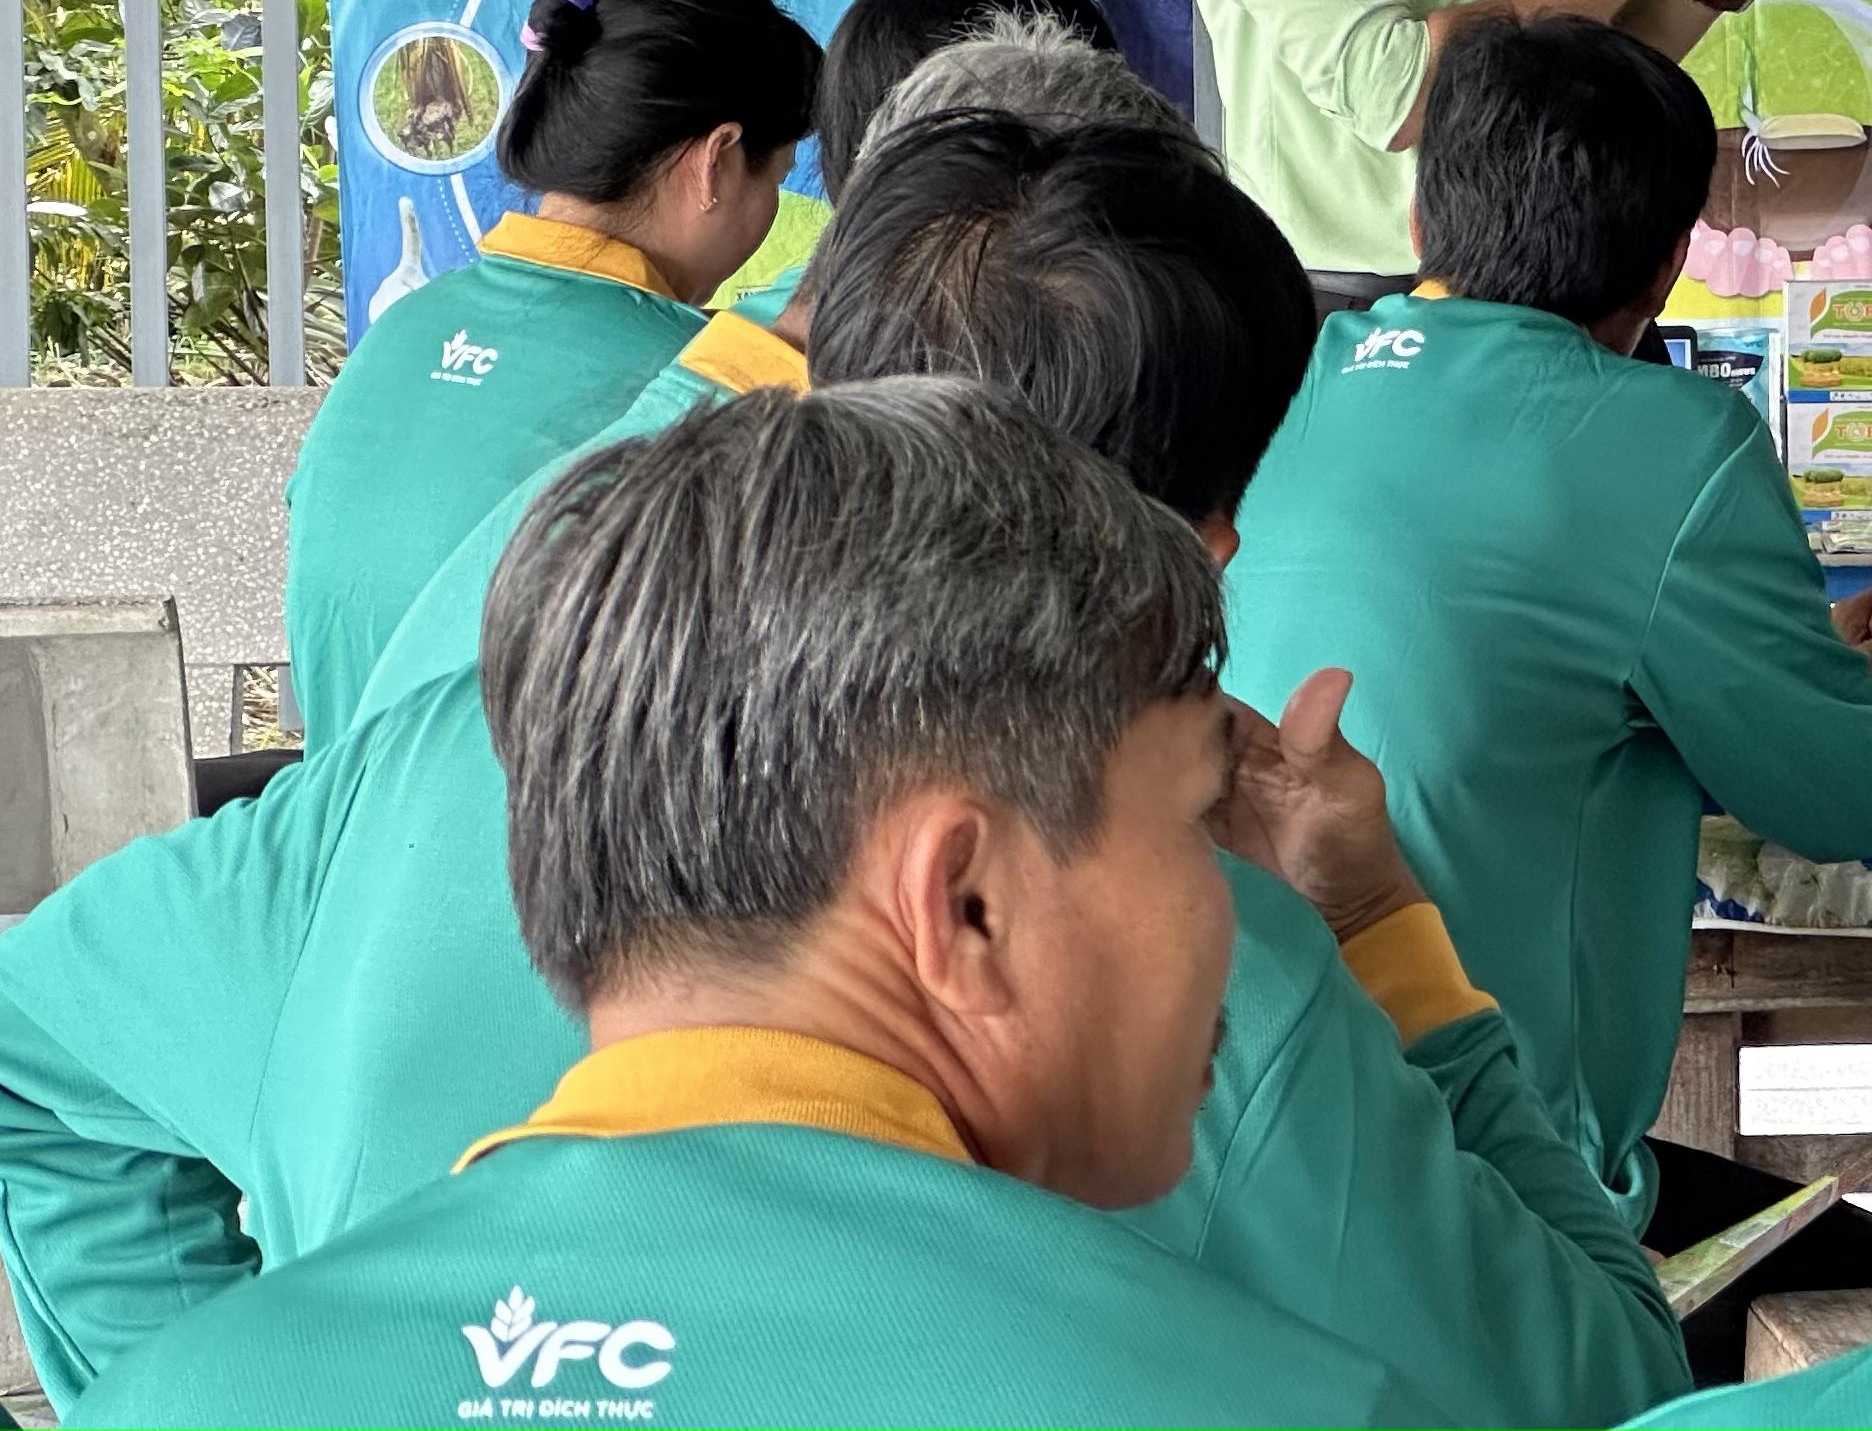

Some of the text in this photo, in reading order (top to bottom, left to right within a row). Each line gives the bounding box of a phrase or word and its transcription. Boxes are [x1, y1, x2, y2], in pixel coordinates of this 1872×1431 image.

[442, 342, 498, 375] VFC
[1355, 330, 1424, 362] VFC
[461, 1321, 675, 1389] VFC
